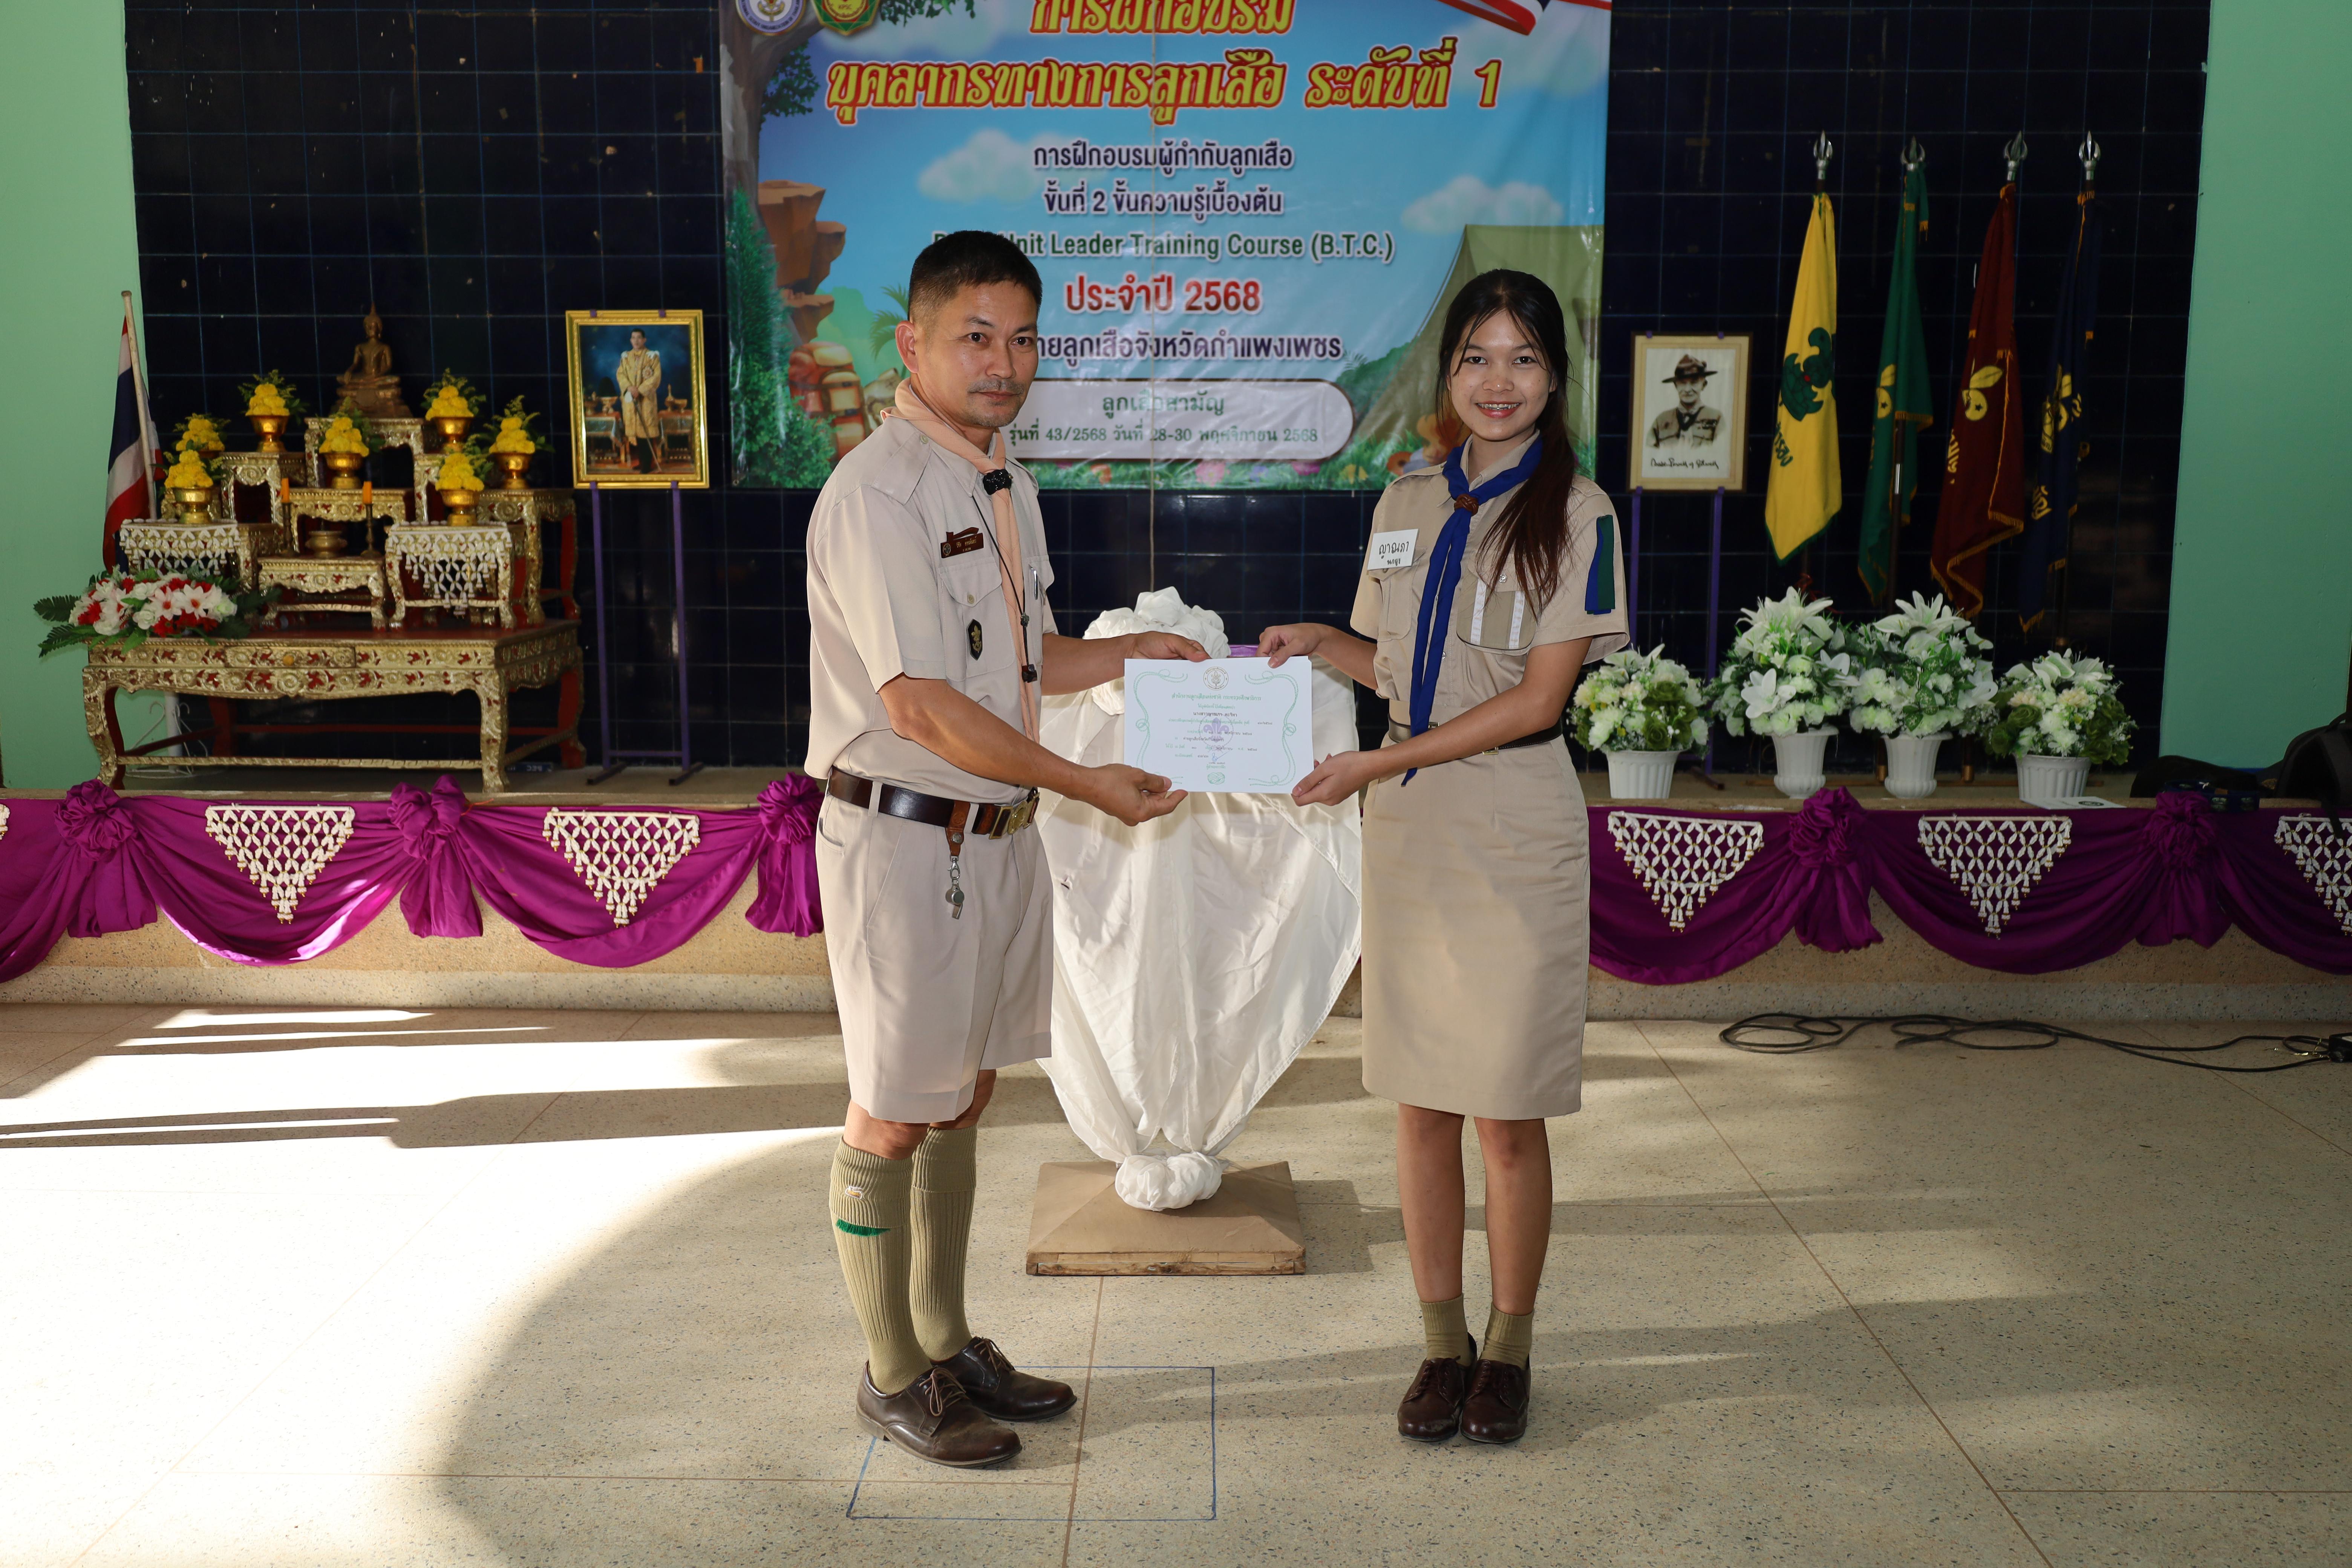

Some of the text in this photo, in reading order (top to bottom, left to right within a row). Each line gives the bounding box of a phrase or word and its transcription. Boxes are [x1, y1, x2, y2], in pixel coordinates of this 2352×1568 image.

[827, 36, 1503, 124] บุคลากรทางการลูกเสือ ระดับที่ 1
[1034, 139, 1292, 175] การฝึกอบรมผู้กำกับลูกเสือ
[1044, 179, 1282, 220] ขั้นที่ 2 ขั้นความรู้เบื้องต้น
[1051, 233, 1123, 254] Leader
[1130, 233, 1220, 260] Training
[1227, 233, 1303, 254] Course
[1311, 232, 1393, 261] (B.T.C.)
[1066, 274, 1260, 311] ประจำปี 2568
[1038, 329, 1341, 367] ายลูกเสือจังหวัดกำแพงเพชร
[1102, 389, 1225, 419] ลูกเสือสามัญ
[1009, 417, 1318, 446] รุ่นที่ 43/2568 วันที่ 28-30 พฤศจิกายน 2568
[1379, 541, 1409, 559] ญาณภา
